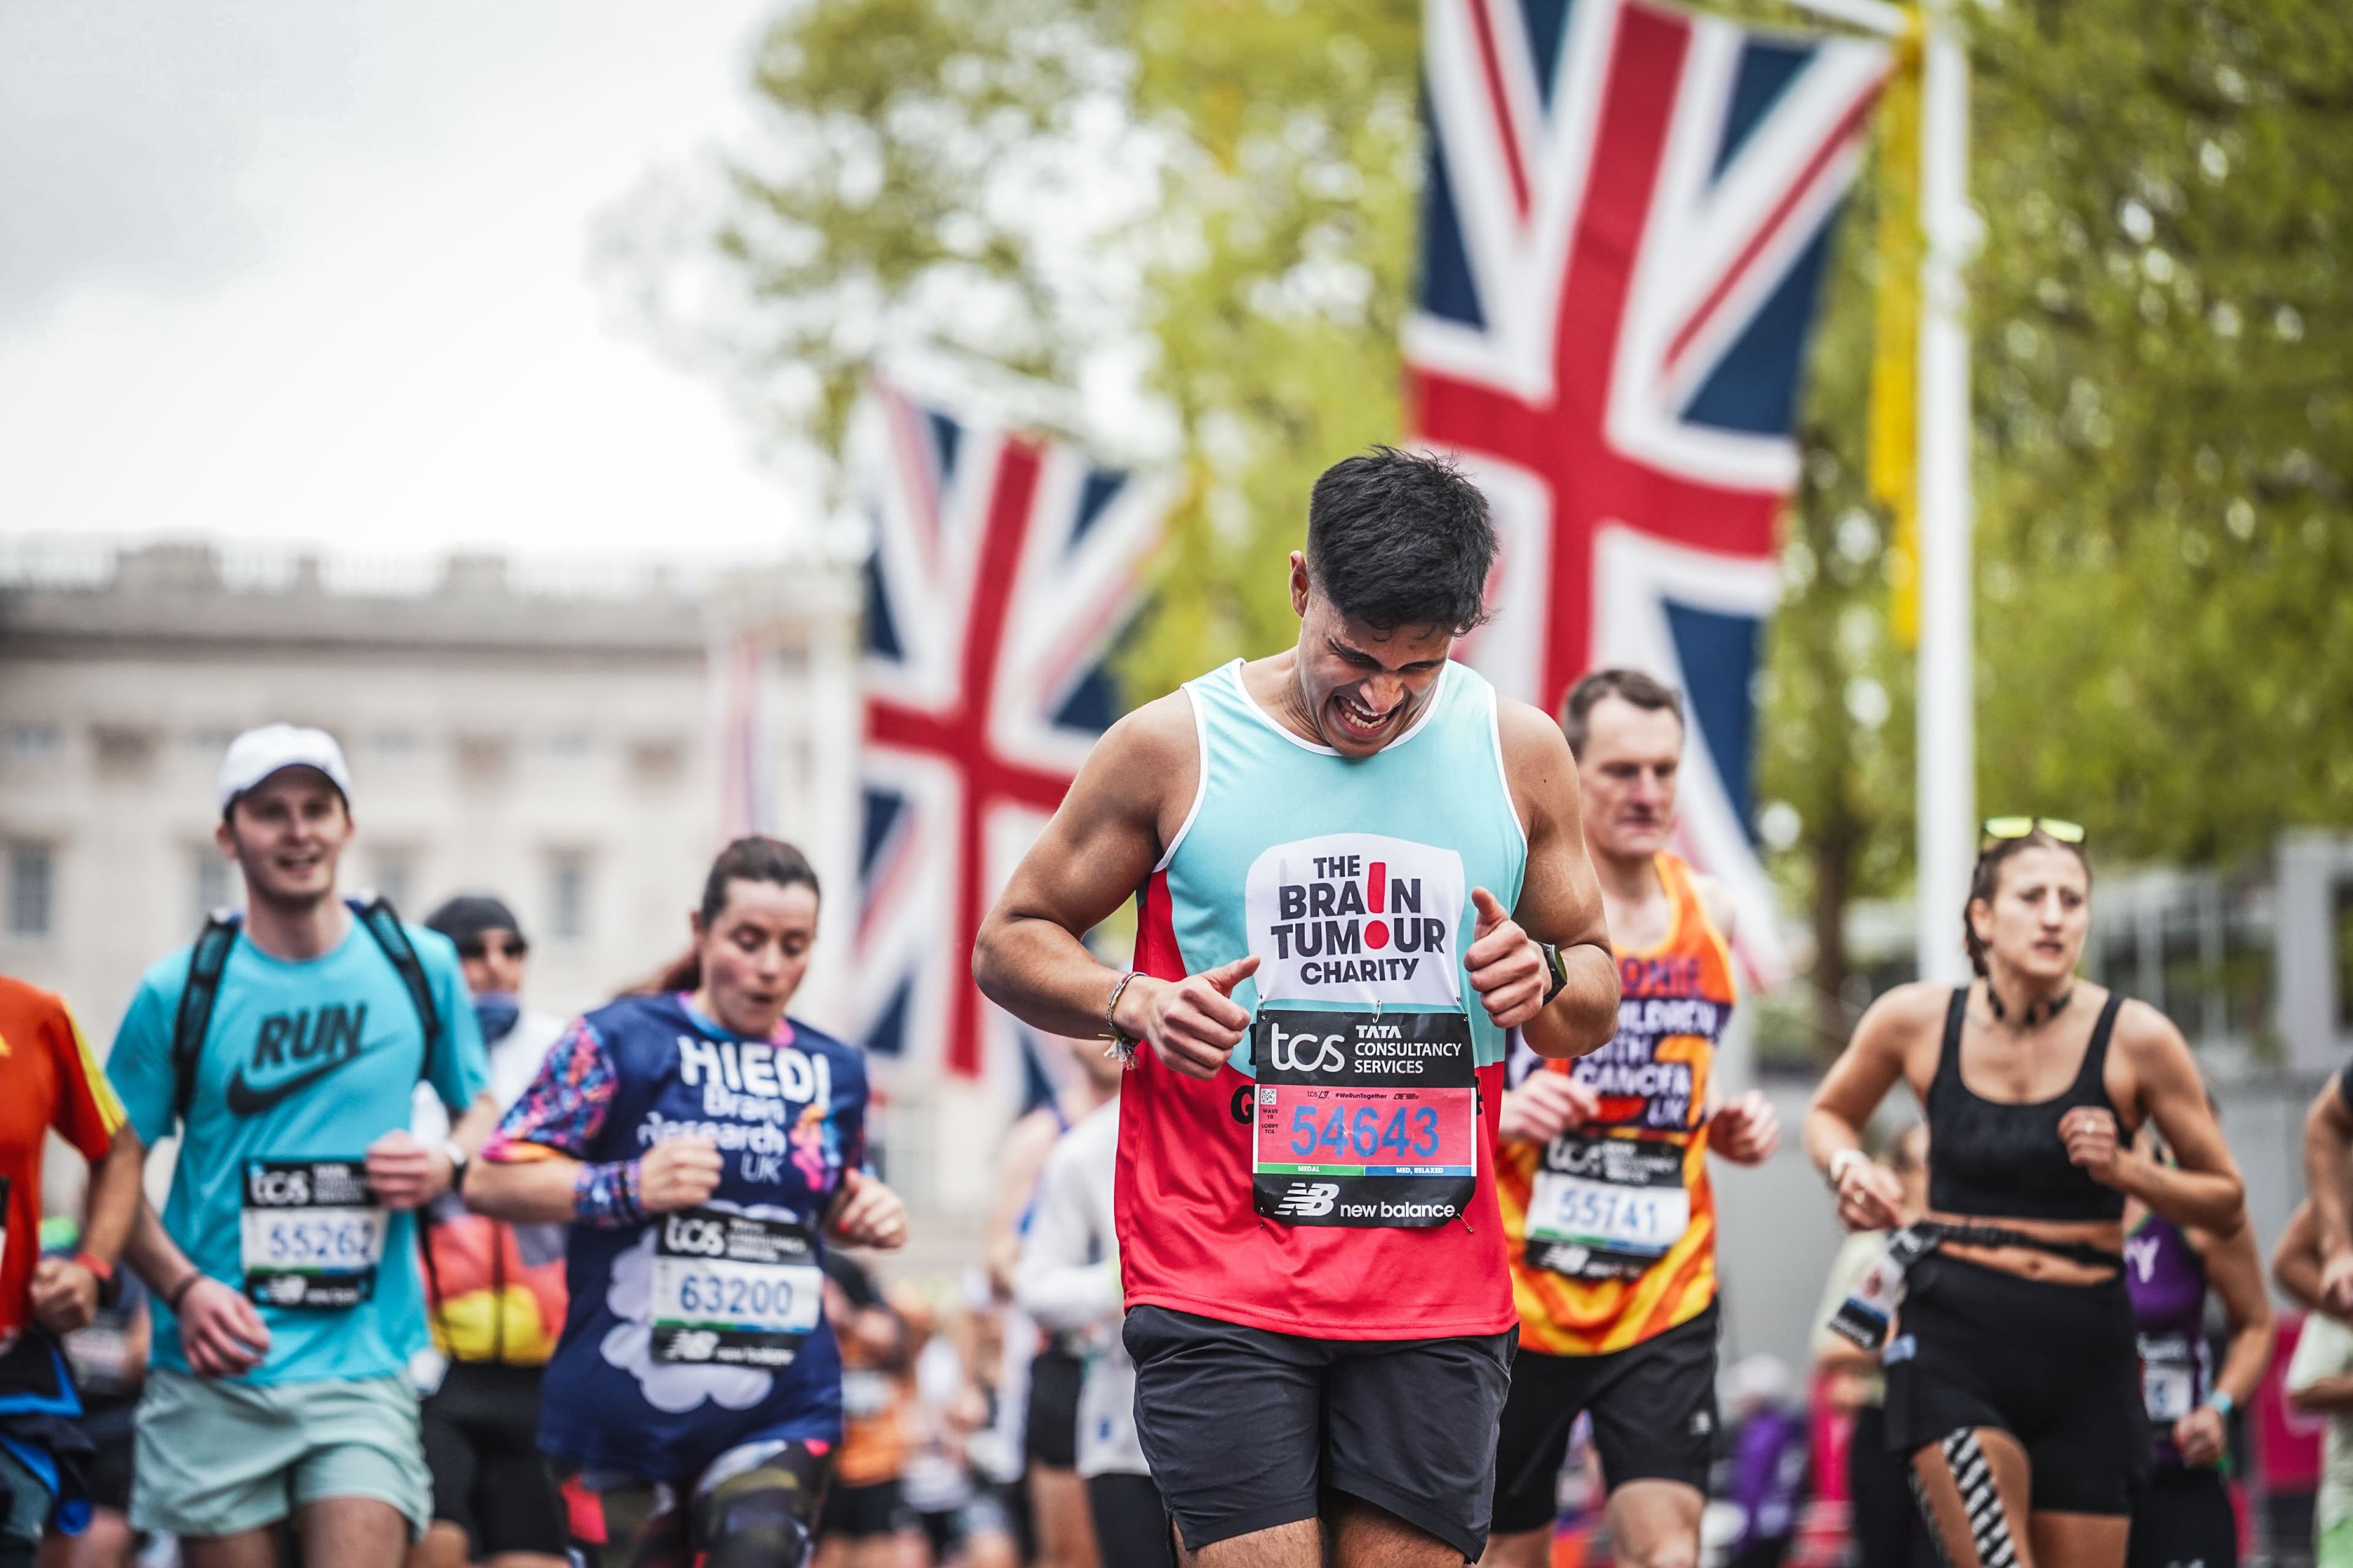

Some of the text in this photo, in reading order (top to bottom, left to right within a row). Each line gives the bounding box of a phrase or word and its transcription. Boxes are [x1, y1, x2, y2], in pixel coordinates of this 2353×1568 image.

[1313, 855, 1360, 879] THE
[1300, 958, 1420, 985] CHARITY
[252, 1002, 368, 1069] RUN
[1271, 1022, 1346, 1072] tcs
[1354, 1042, 1462, 1057] CONSULTANCY
[1355, 1025, 1402, 1039] TATA
[1354, 1059, 1424, 1074] SERVICES
[1289, 1105, 1440, 1157] 54643
[740, 1149, 783, 1184] UK
[1339, 1201, 1456, 1218] new balance
[1558, 1187, 1659, 1233] 55741
[665, 1214, 725, 1256] tcs
[680, 1273, 794, 1317] 63200
